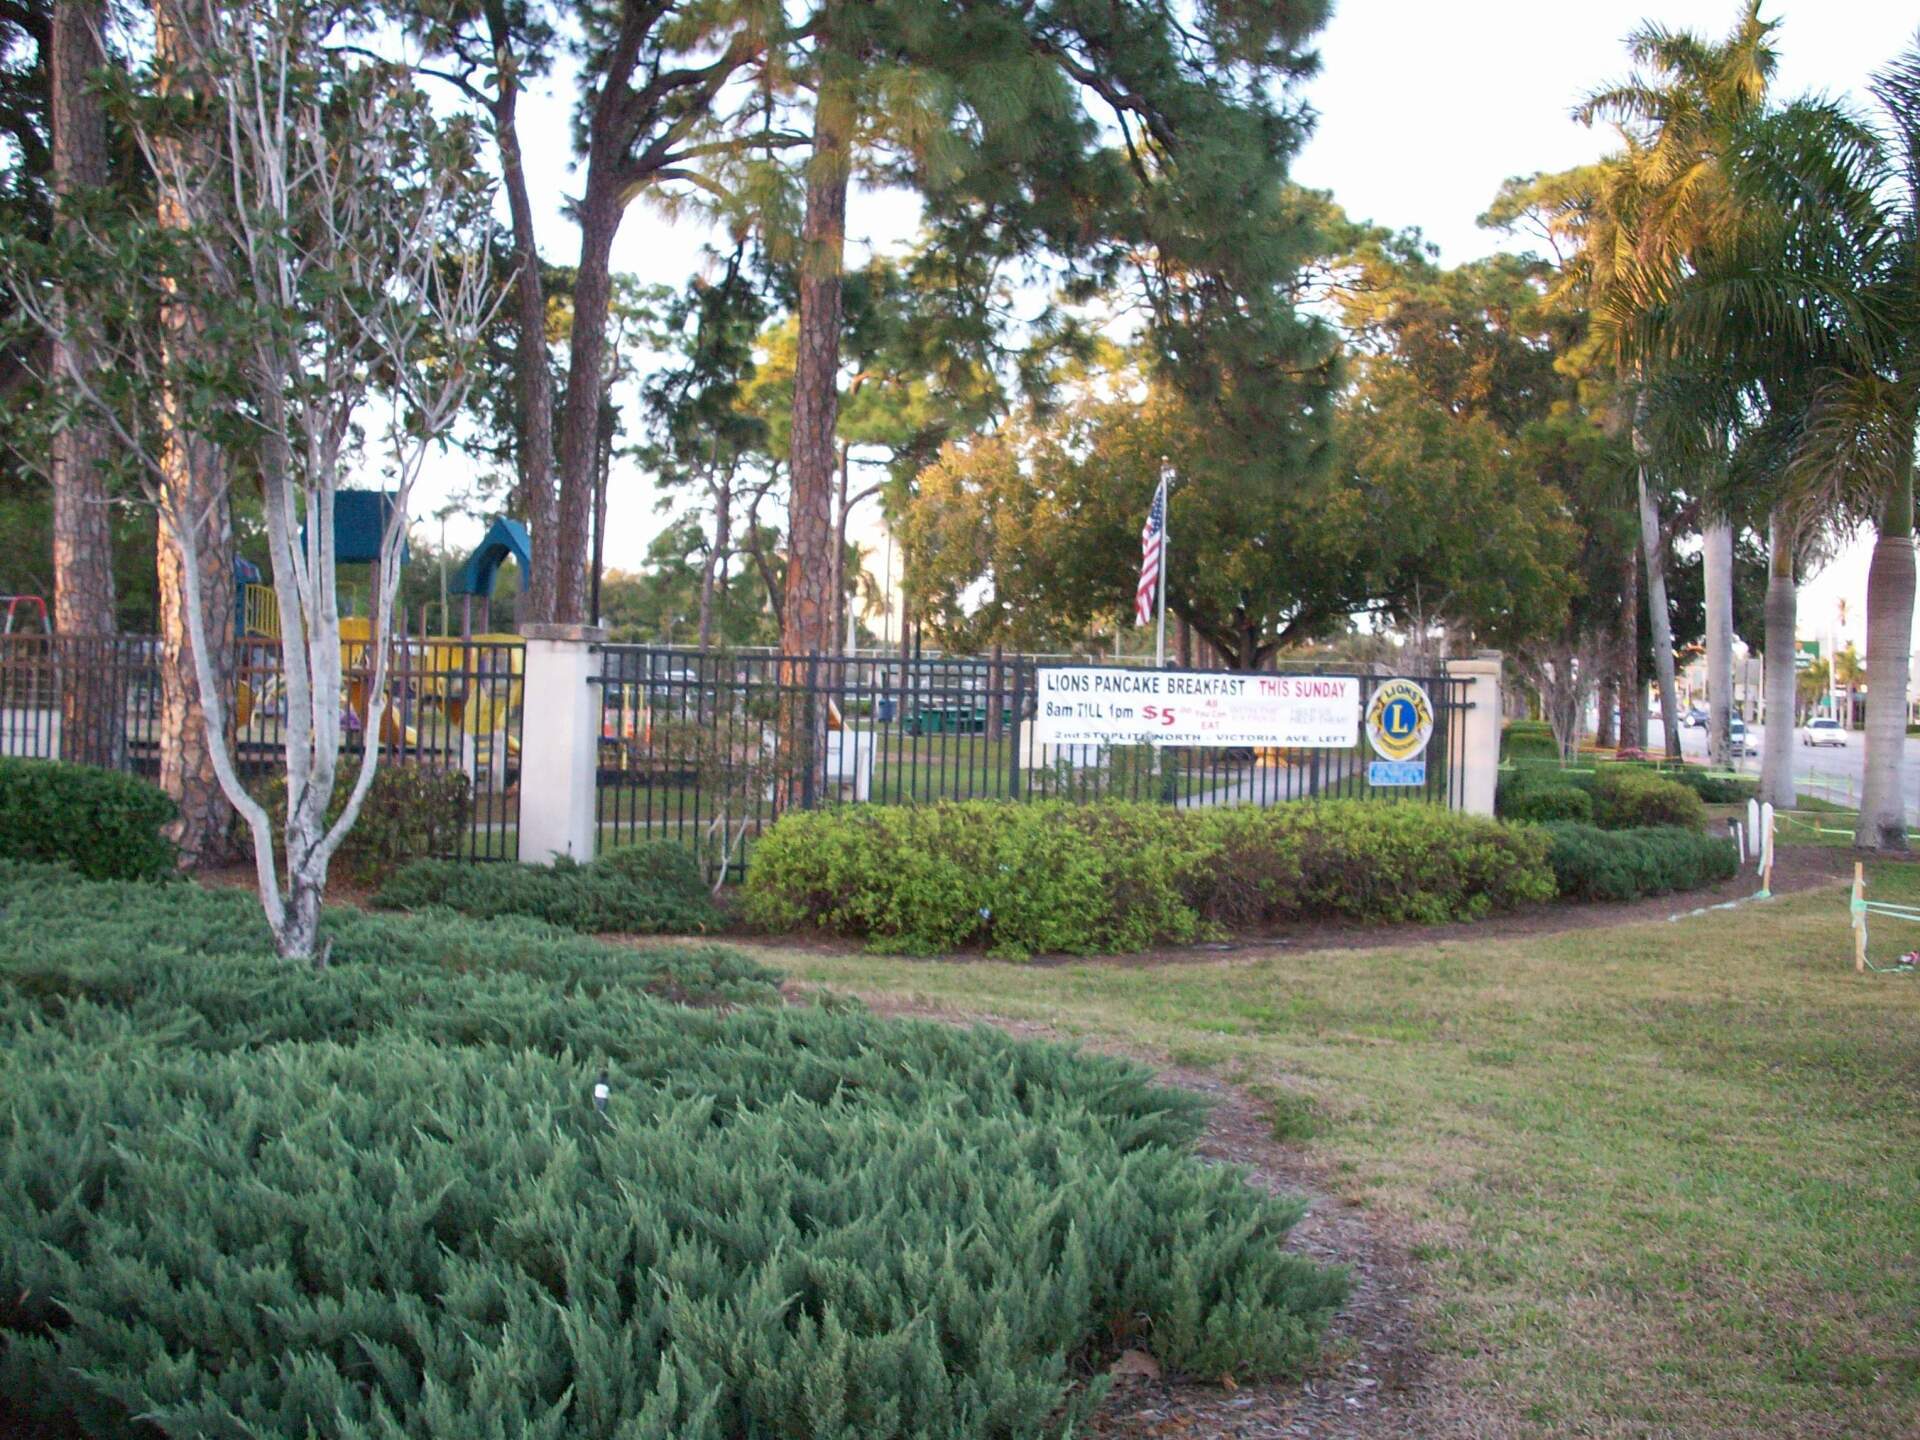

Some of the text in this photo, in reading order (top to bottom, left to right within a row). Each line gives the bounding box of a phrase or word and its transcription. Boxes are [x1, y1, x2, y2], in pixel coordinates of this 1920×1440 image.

[1047, 674, 1347, 699] LIONS PANCAKE BREAKFAST THIS SUNDAY
[1384, 684, 1419, 701] LIONS
[1046, 701, 1073, 718] 8am
[1076, 702, 1103, 719] TILL
[1109, 702, 1134, 721] 1pm
[1391, 704, 1408, 733] L
[1055, 731, 1080, 740] 2nd
[1153, 733, 1201, 742] NORTH
[1216, 733, 1277, 742] VICTORIA
[1318, 735, 1347, 743] LEFT
